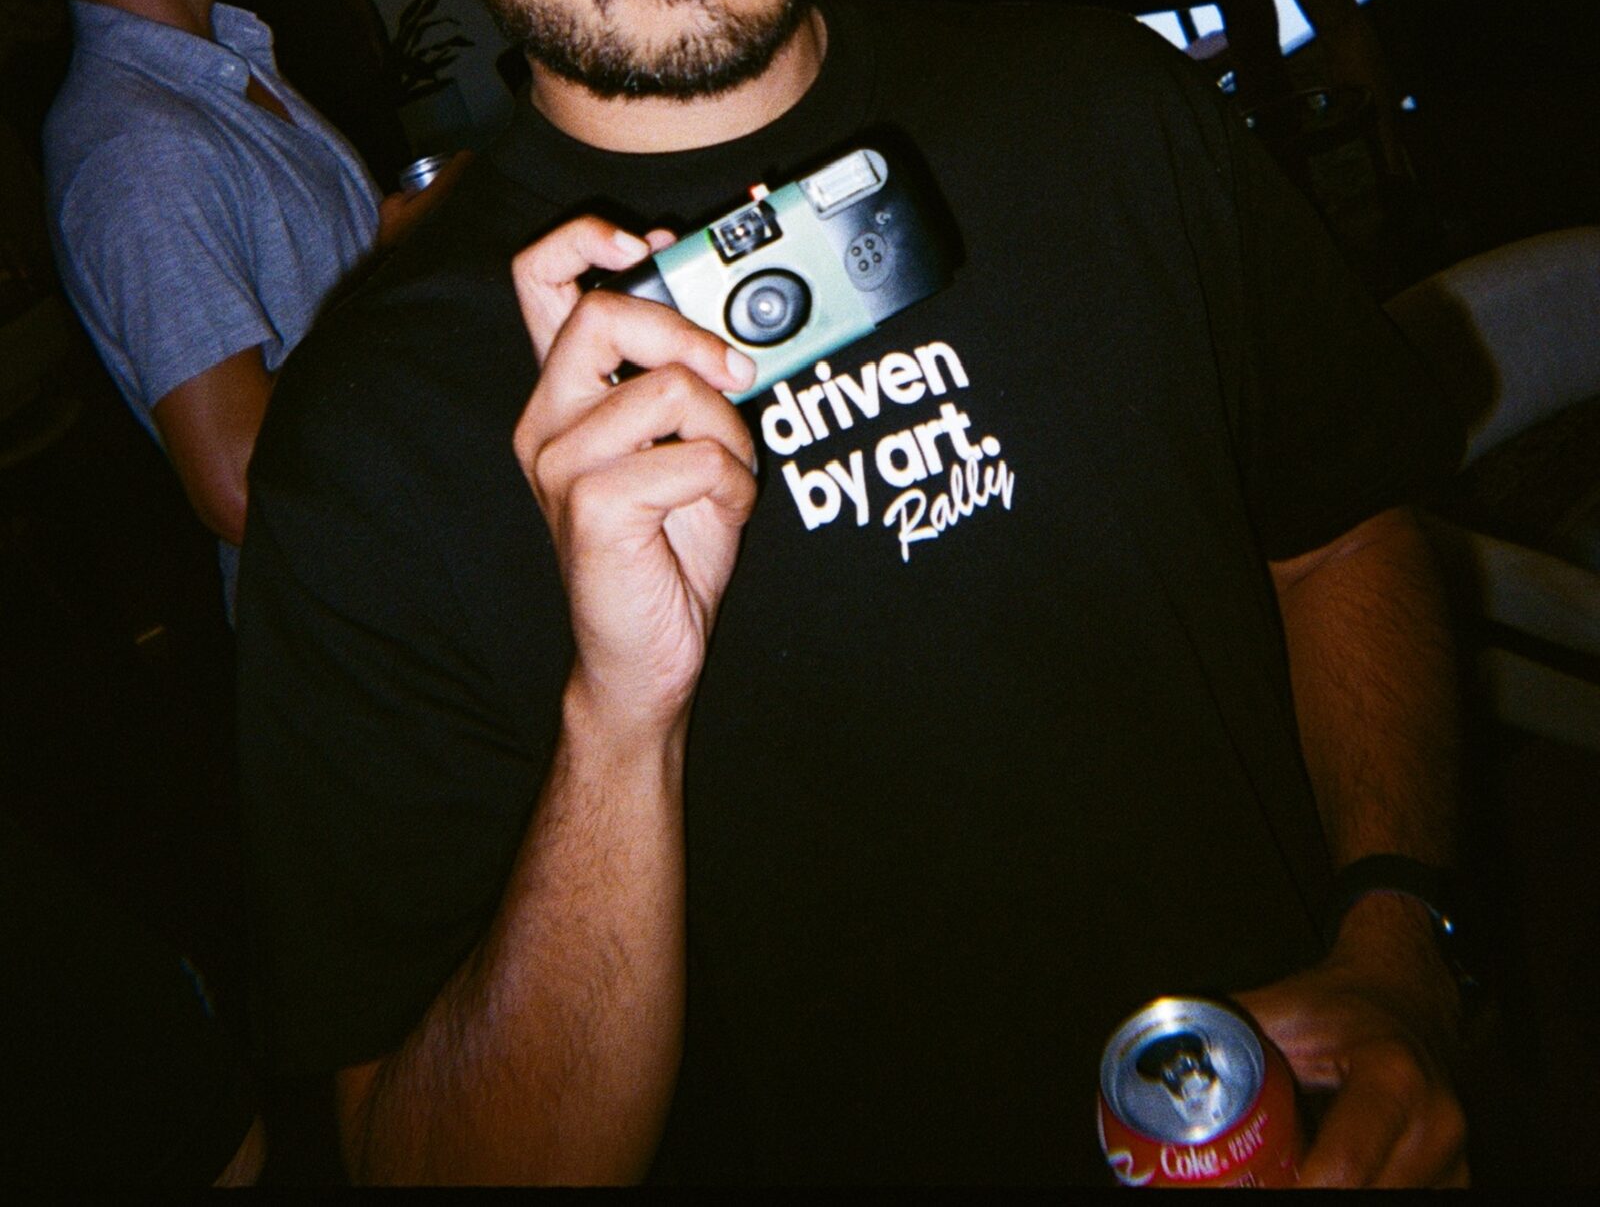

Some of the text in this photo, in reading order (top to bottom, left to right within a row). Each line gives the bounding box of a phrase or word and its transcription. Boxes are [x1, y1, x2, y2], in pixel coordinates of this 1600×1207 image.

[761, 341, 969, 455] driven
[781, 403, 1000, 530] by art.
[883, 456, 1014, 562] Rally
